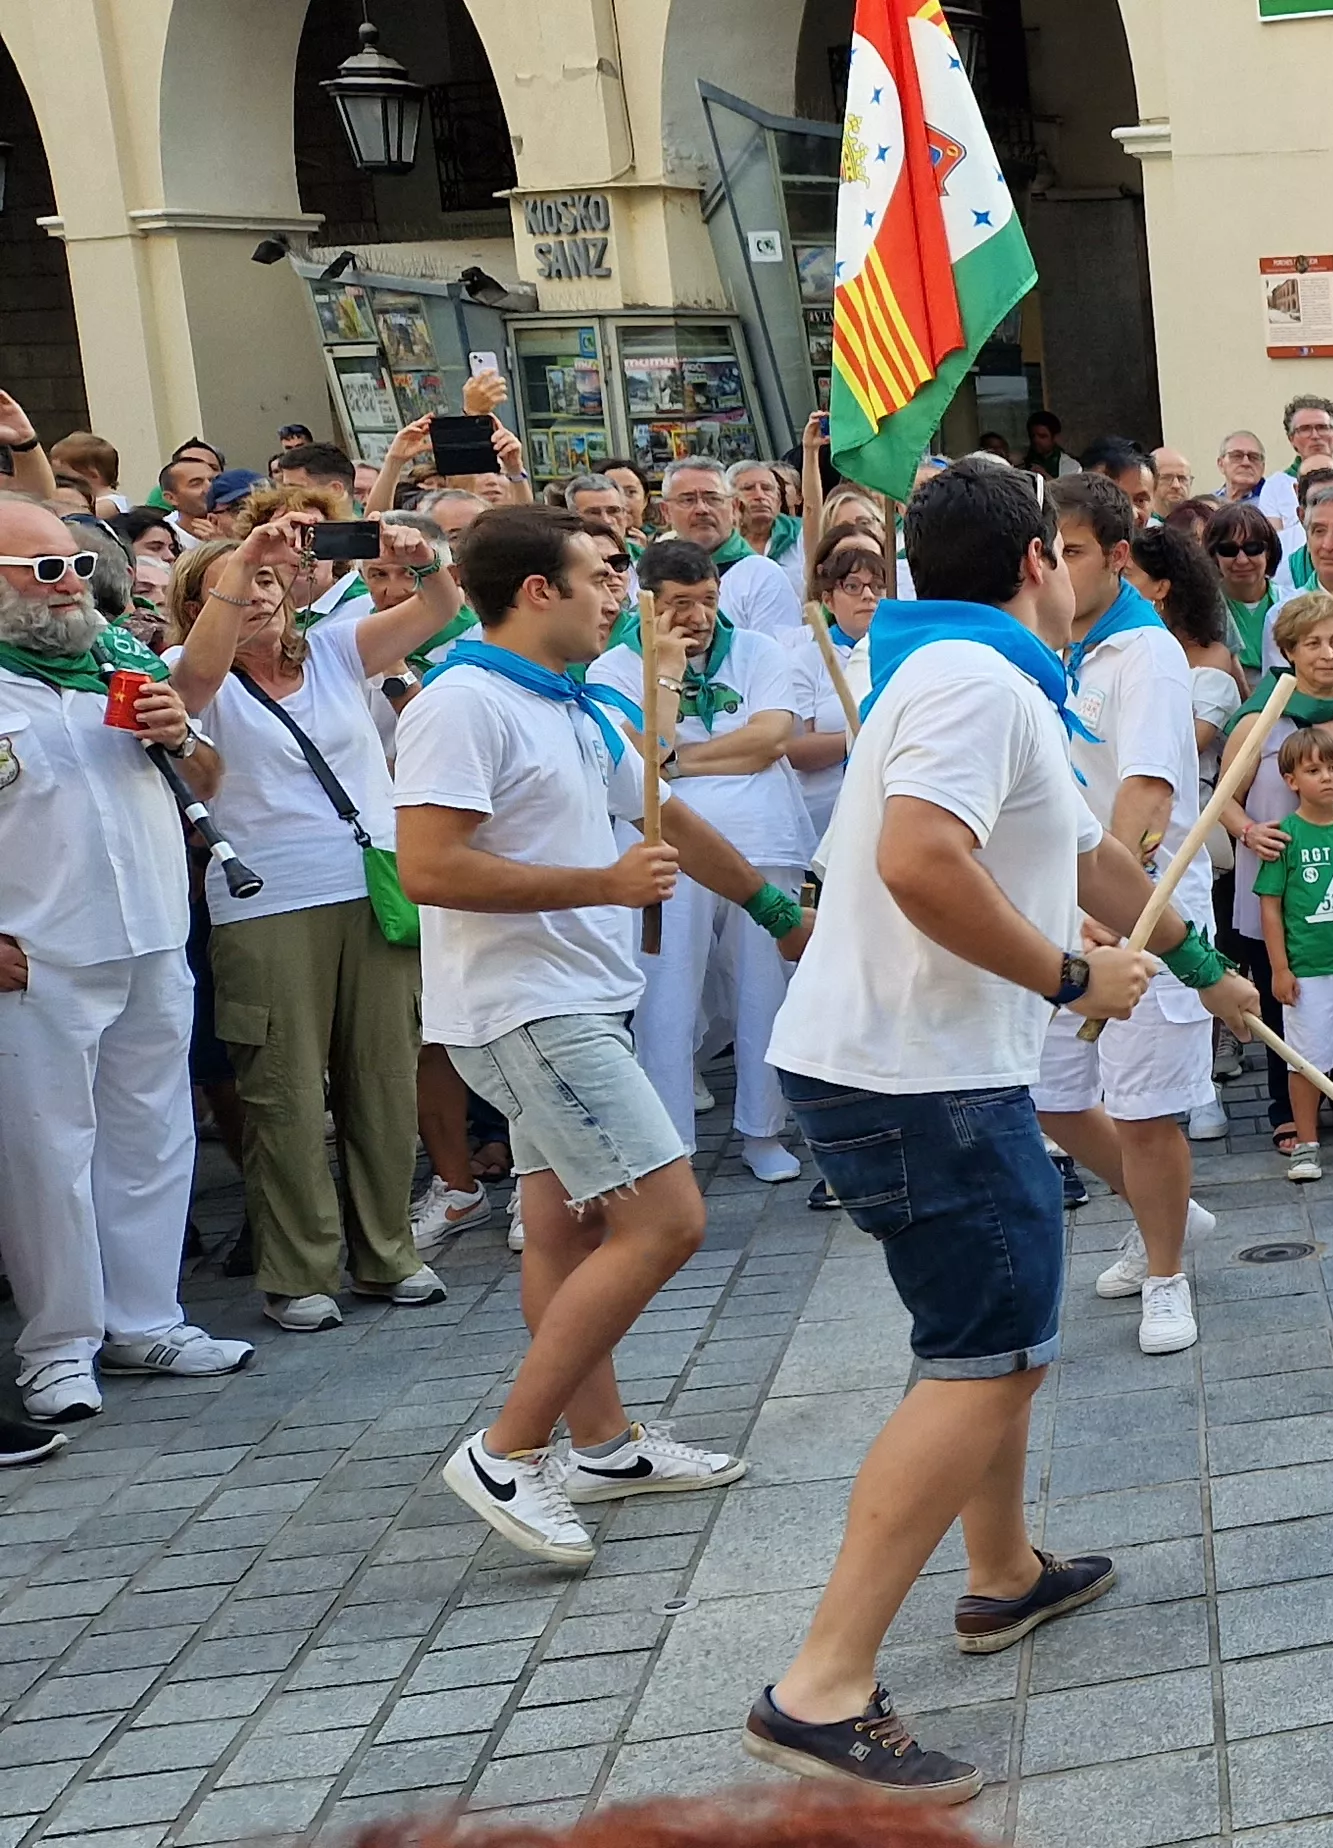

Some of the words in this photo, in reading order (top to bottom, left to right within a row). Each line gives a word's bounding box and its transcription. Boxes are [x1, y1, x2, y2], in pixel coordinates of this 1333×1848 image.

[524, 194, 611, 236] KIOSKO
[534, 237, 612, 281] SANZ
[1301, 847, 1331, 863] RGT
